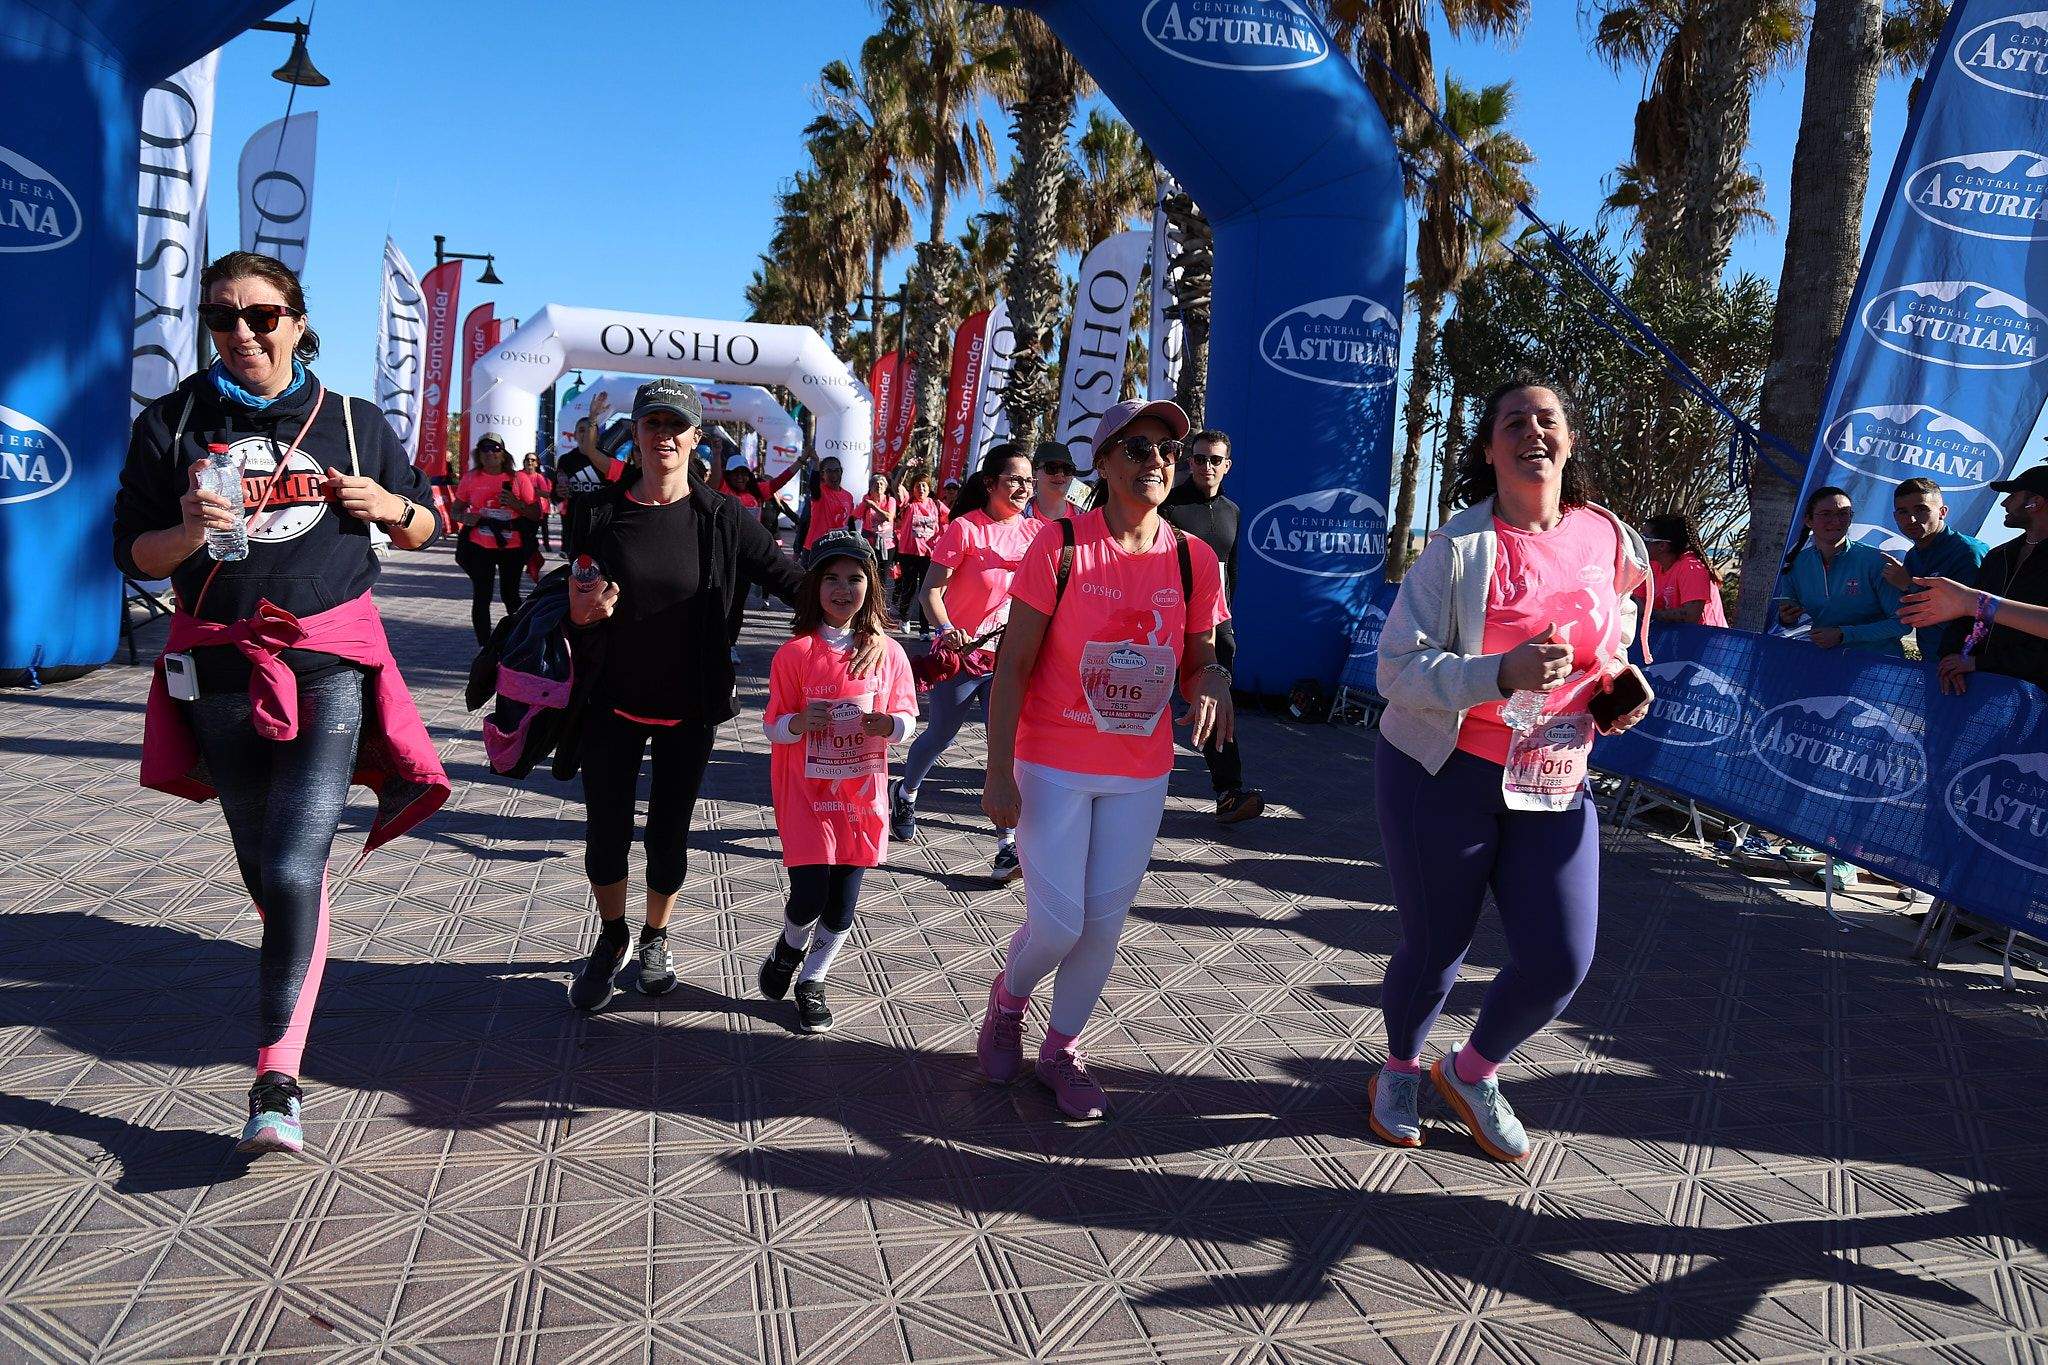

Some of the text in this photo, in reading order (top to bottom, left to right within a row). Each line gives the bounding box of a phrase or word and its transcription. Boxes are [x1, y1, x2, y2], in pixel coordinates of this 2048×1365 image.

[1193, 1, 1311, 28] CENTRAL LECHERA
[1157, 1, 1321, 54] ASTURIANA
[1955, 174, 2019, 191] CENTRAL
[1909, 301, 2040, 332] CENTRAL LECHERA
[426, 288, 448, 380] Santander
[1304, 324, 1361, 336] CENTRAL
[1873, 301, 2038, 358] ASTURIANA
[600, 323, 759, 366] OYSHO
[500, 351, 551, 365] OYSHO
[803, 374, 848, 386] OYSHO
[957, 333, 984, 421] Santander
[877, 371, 891, 437] Santander
[475, 413, 523, 426] OYSHO
[420, 408, 439, 464] Sports
[1866, 424, 1987, 457] CENTRAL LECHERA
[825, 439, 867, 451] OYSHO
[1833, 422, 1984, 482] ASTURIANA
[1292, 517, 1348, 528] CENTRAL
[1082, 583, 1122, 600] OYSHO
[1109, 656, 1144, 666] ASTURIANA
[802, 685, 837, 695] OYSHO
[1105, 684, 1142, 700] 016
[833, 732, 865, 749] 016
[1760, 716, 1907, 792] ASTURIANA
[816, 766, 842, 775] OYSHO
[1542, 759, 1573, 775] 016
